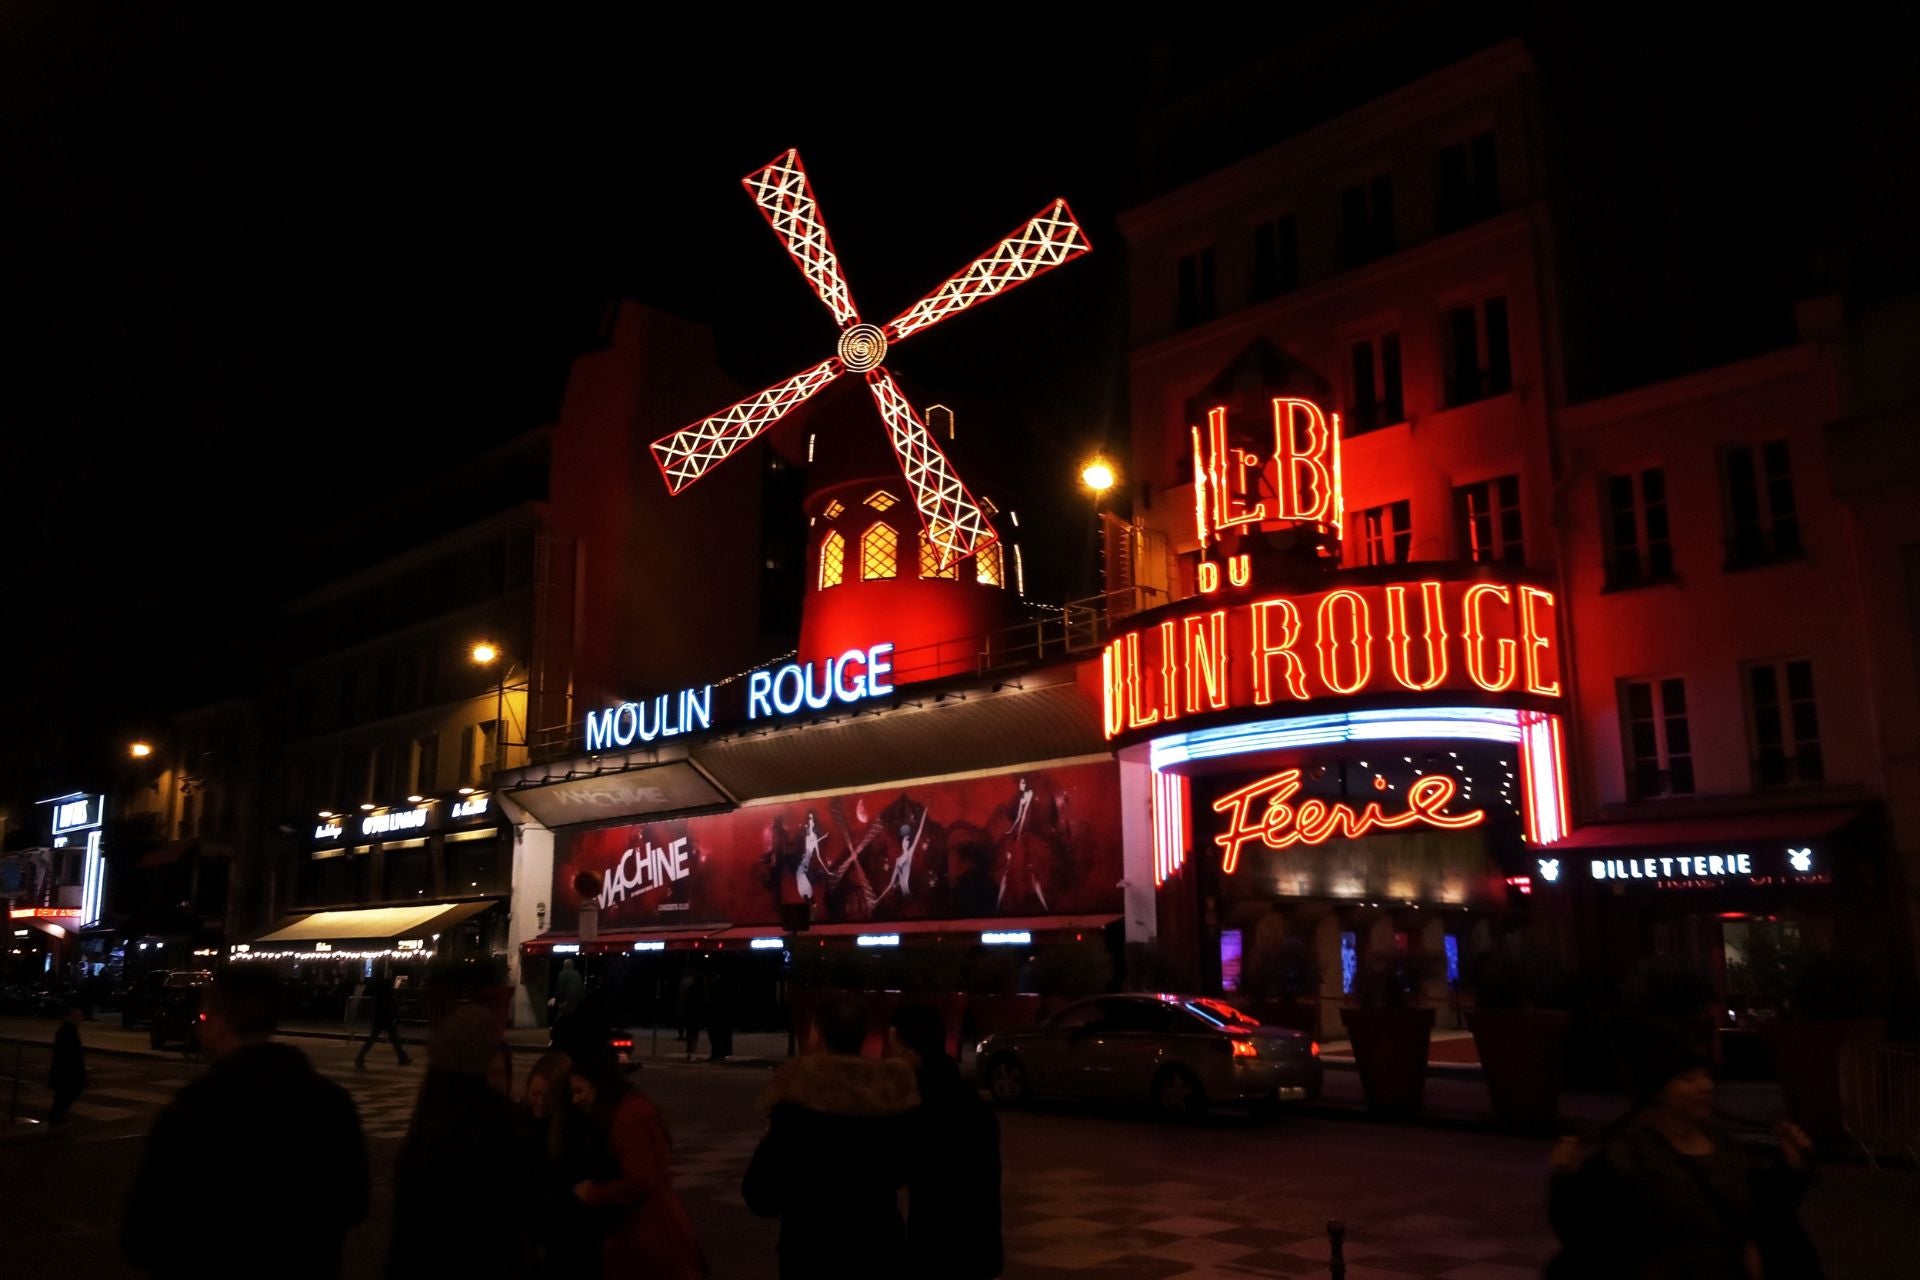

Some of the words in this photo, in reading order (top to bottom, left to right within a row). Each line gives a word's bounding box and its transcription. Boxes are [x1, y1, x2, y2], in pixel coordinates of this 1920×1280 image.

[1198, 554, 1251, 593] DU
[1250, 581, 1562, 705] ROUGE
[585, 685, 712, 752] MOULIN
[748, 642, 895, 720] ROUGE
[1212, 769, 1486, 874] Féerie
[593, 837, 690, 910] MACHINE
[1590, 853, 1753, 880] BILLETTERIE
